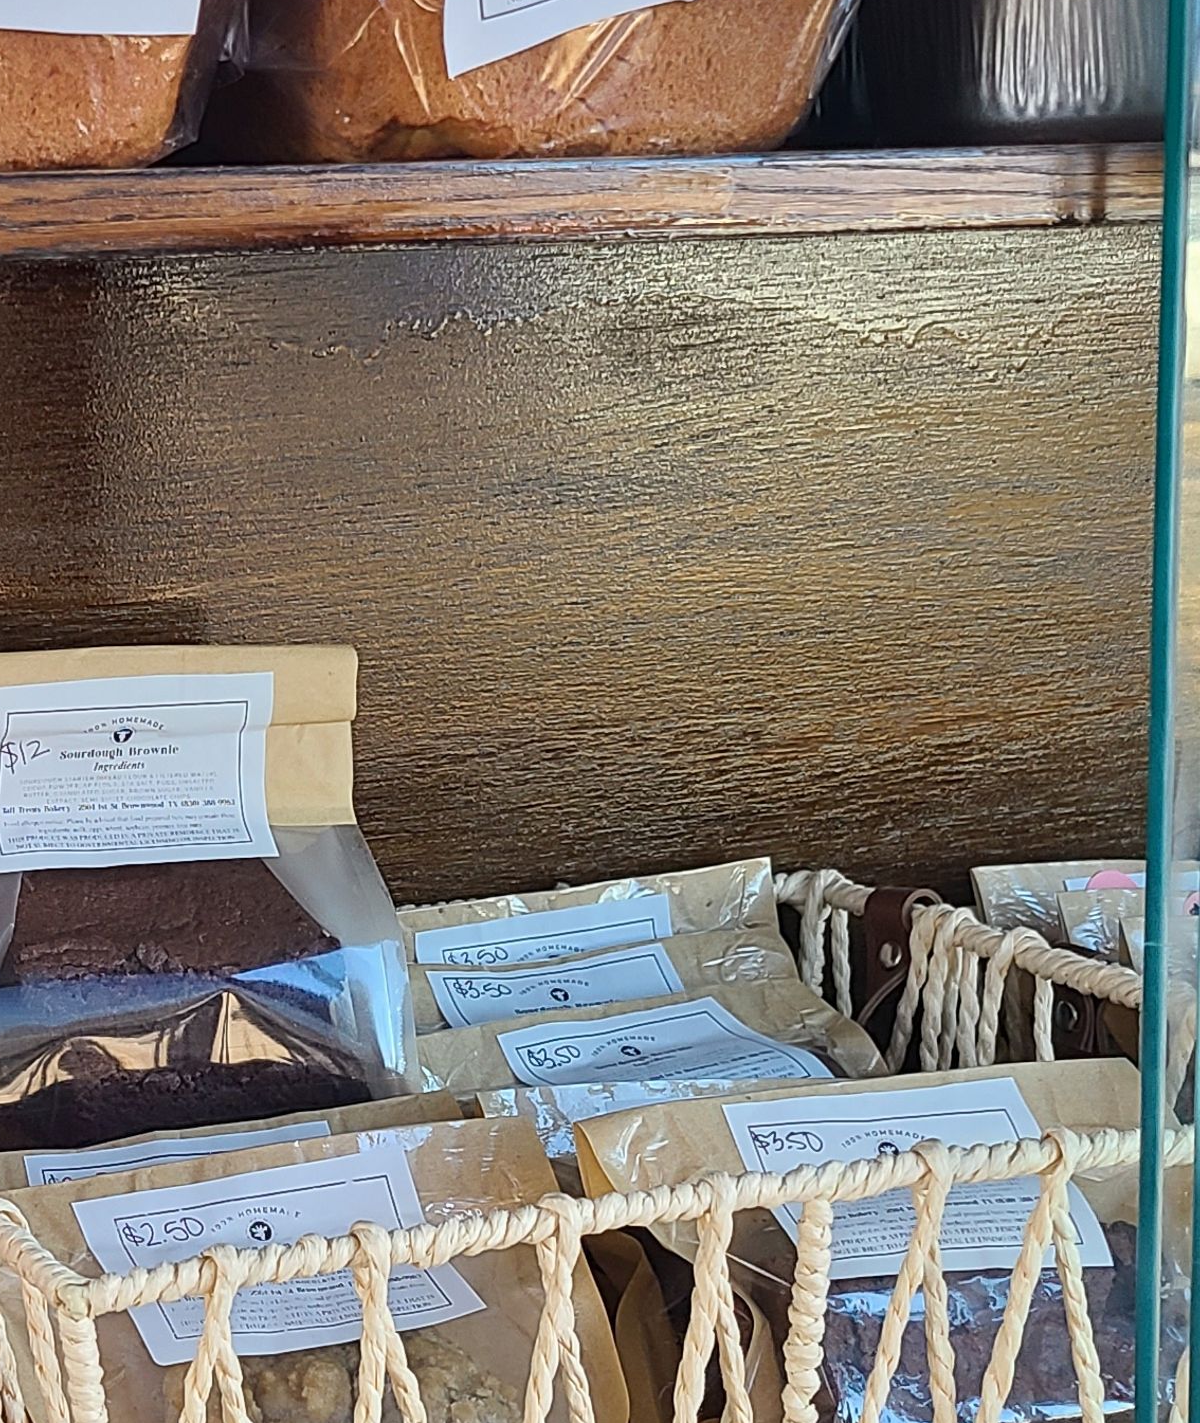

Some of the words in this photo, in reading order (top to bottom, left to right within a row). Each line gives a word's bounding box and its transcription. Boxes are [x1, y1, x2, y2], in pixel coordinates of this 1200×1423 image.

[111, 716, 165, 730] HOMEMADE
[1, 740, 50, 775] $12
[58, 746, 123, 760] Sourdough
[128, 743, 179, 757] Brownie
[92, 759, 145, 773] Ingredients
[122, 1217, 204, 1246] $2.50
